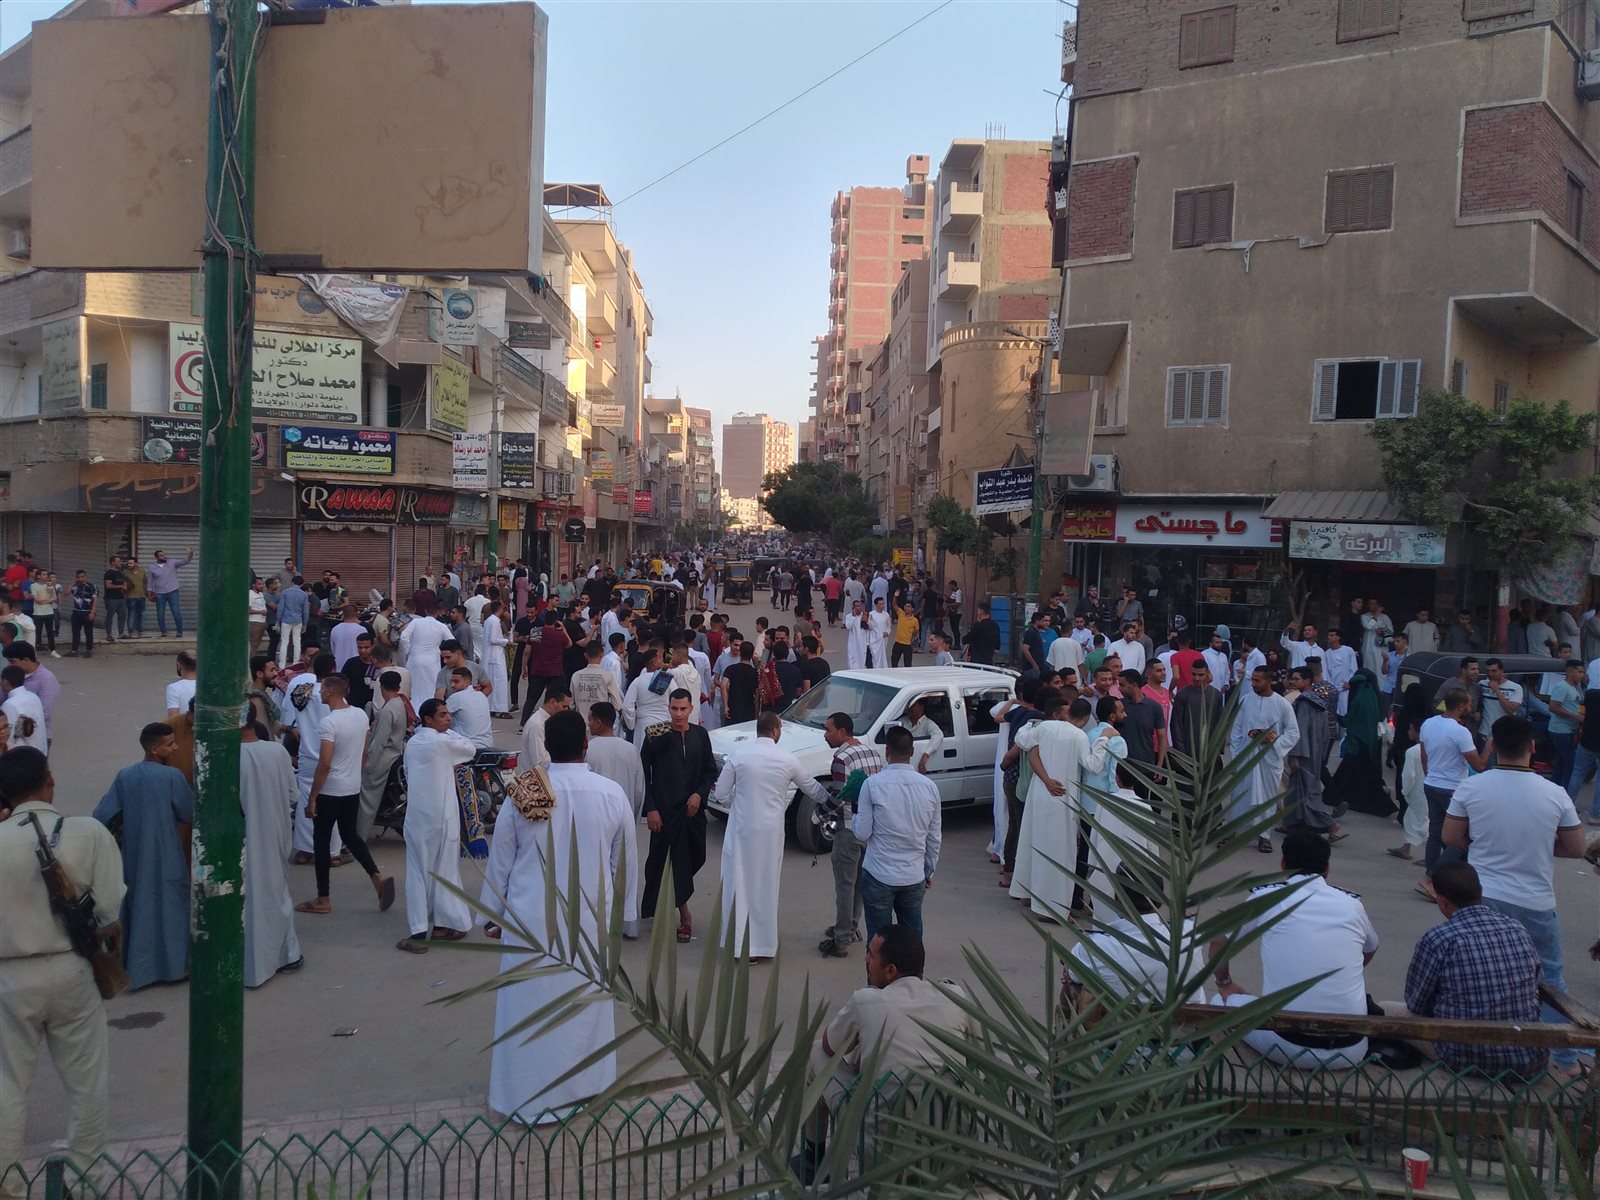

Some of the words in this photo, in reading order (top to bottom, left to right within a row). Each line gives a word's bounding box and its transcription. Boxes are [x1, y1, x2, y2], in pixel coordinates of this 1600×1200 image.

[327, 343, 356, 359] مركز
[267, 356, 308, 368] دكتور
[276, 370, 315, 388] صلاح
[319, 375, 356, 390] محمد
[174, 422, 202, 431] لتحاليل
[302, 435, 349, 450] شحاته
[352, 440, 392, 455] محمود
[519, 444, 533, 454] محمد
[979, 478, 996, 490] التواب
[996, 478, 1006, 488] عبد
[1017, 473, 1033, 484] فاطمة
[301, 485, 396, 519] RAWAA
[1345, 537, 1393, 555] البركة
